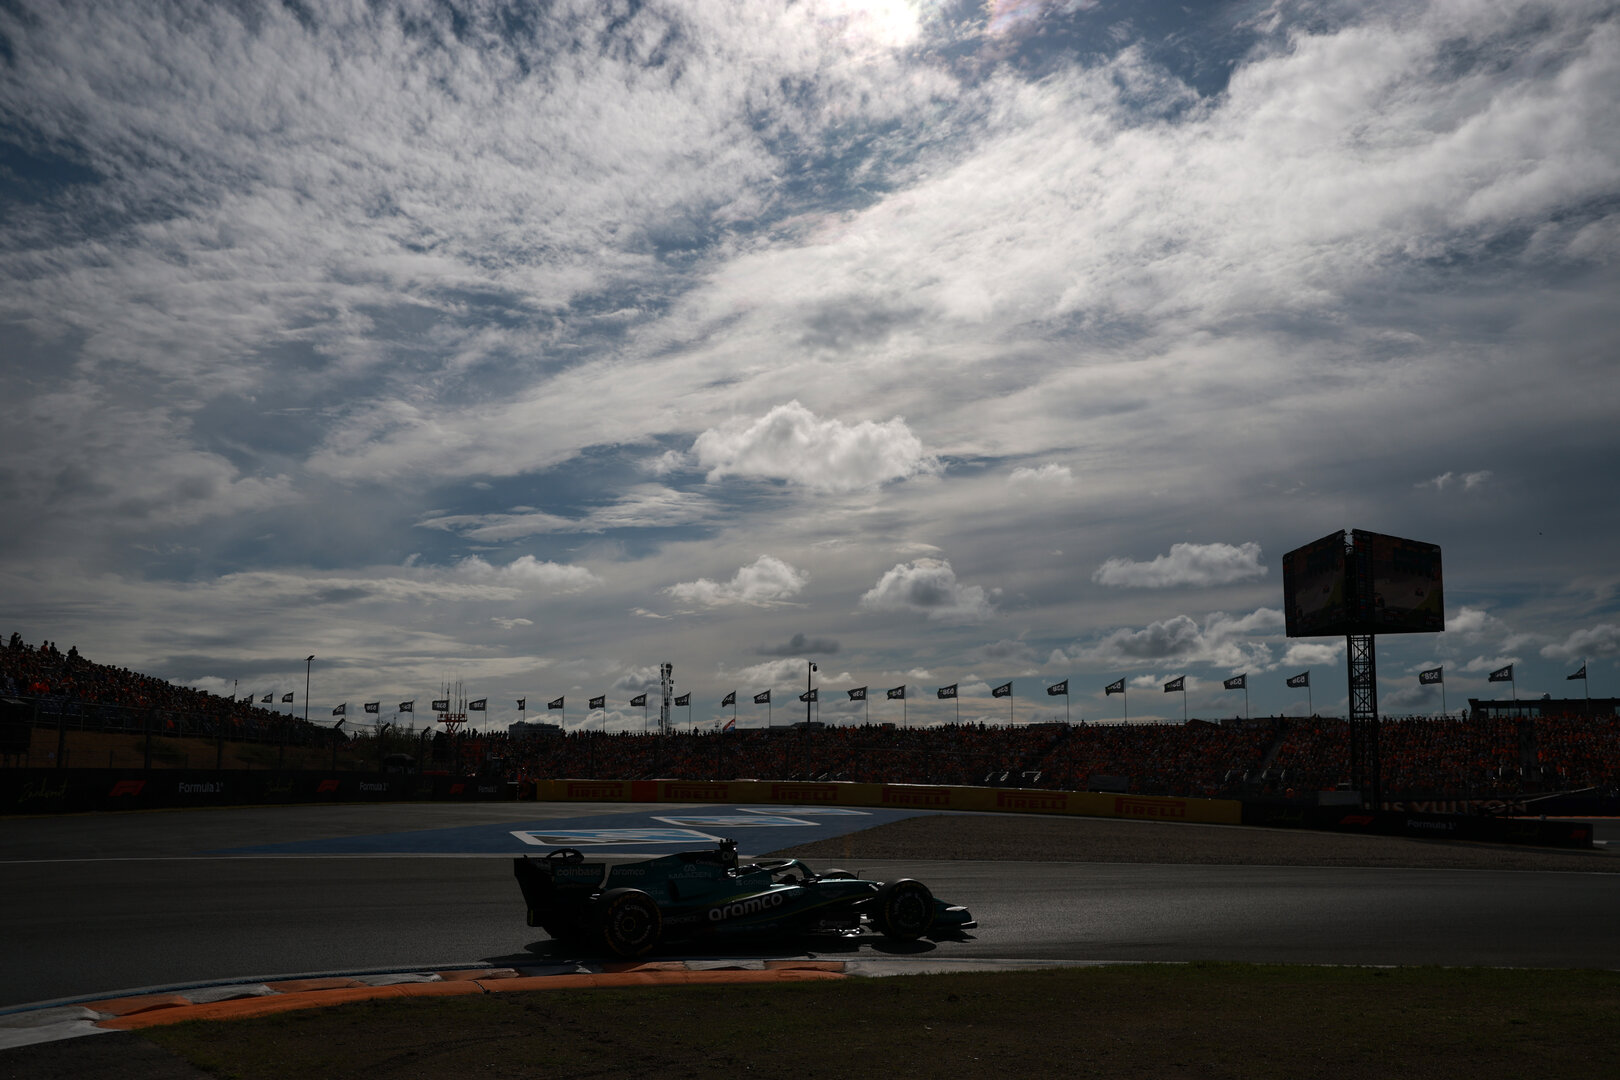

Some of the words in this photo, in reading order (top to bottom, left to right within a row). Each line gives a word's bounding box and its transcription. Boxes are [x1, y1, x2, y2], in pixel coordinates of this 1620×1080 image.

[178, 782, 215, 793] Formula
[359, 781, 384, 792] Formula
[567, 782, 624, 798] PIRELLI
[664, 783, 729, 799] PIRELLI
[771, 783, 838, 801] PIRELLI
[882, 786, 950, 805] PIRELLI
[997, 791, 1068, 810] PIRELLI
[1115, 796, 1186, 817] PIRELLI
[1406, 819, 1446, 831] Formula
[556, 865, 602, 877] coinbase
[611, 868, 646, 876] aramco
[708, 893, 784, 922] aramco
